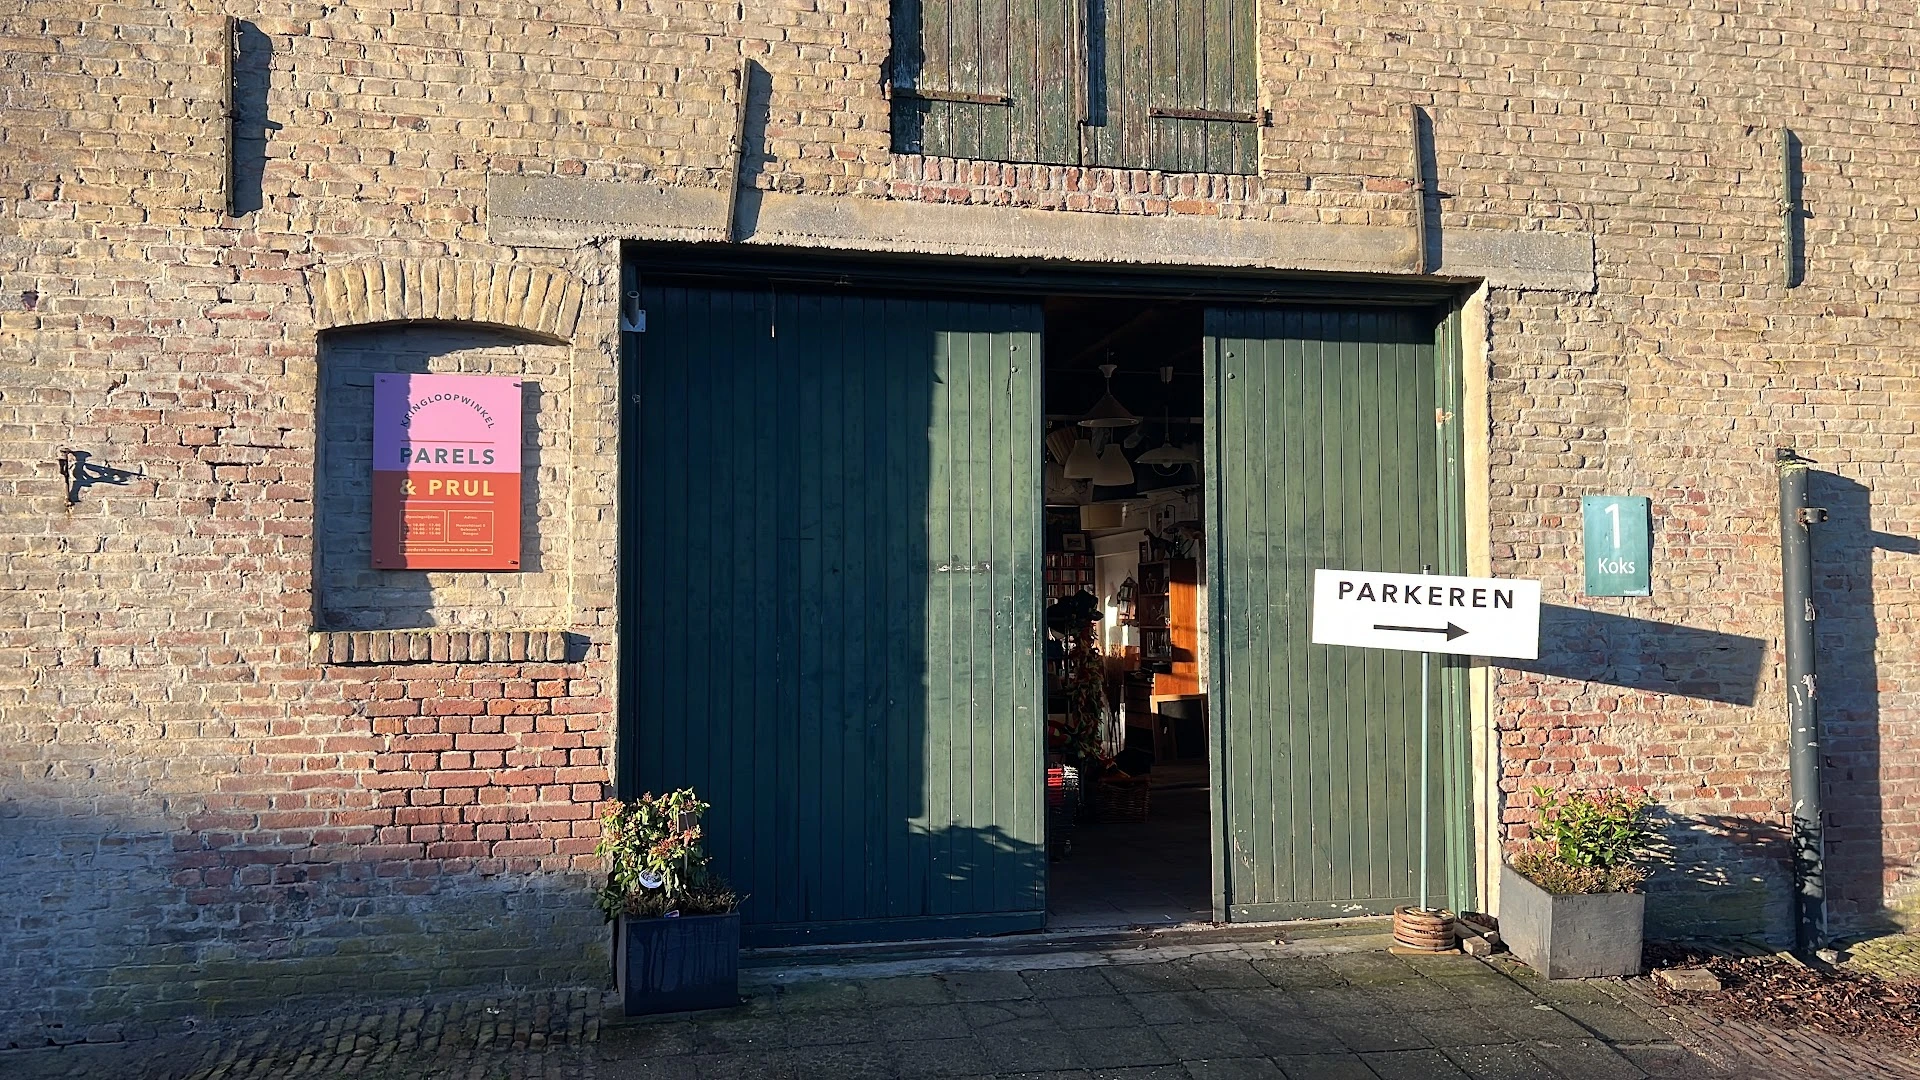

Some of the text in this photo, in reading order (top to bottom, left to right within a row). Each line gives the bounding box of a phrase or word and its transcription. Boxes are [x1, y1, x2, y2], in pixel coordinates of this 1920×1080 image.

[400, 393, 495, 429] KRINGLOOPWINKEL
[400, 447, 495, 465] PARELS
[400, 478, 495, 496] & PRUL
[1604, 503, 1621, 549] 1
[1598, 557, 1636, 574] Koks
[1338, 580, 1513, 609] PARKEREN
